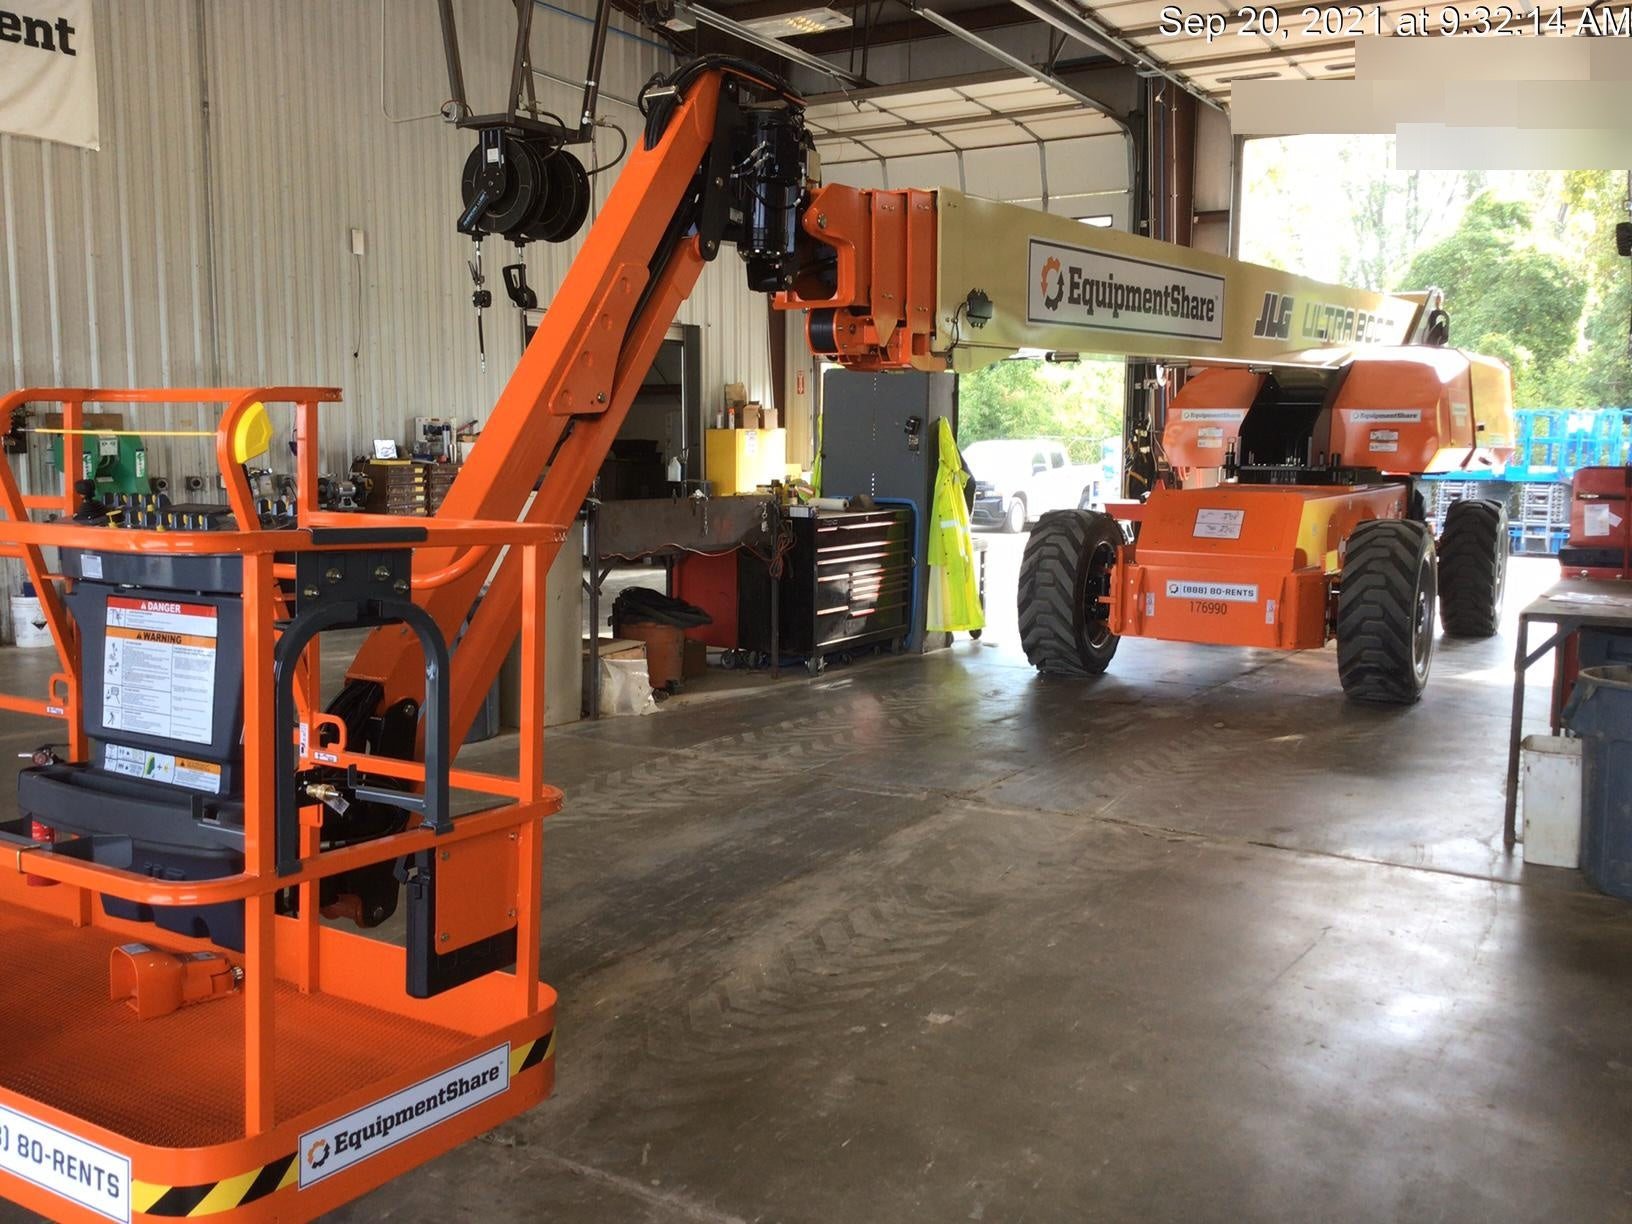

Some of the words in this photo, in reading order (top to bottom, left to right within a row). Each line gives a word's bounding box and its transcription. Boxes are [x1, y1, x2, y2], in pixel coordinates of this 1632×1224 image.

[1068, 266, 1215, 322] EquipmentShare
[1253, 291, 1294, 339] JLG
[1183, 585, 1208, 594] (888)
[1210, 587, 1254, 597] 80-RENTS
[147, 601, 181, 614] DANGER
[1189, 601, 1228, 615] 176990
[143, 631, 182, 645] WARNING
[334, 1065, 500, 1155] EquipmentShare
[17, 1133, 119, 1199] 80-RENTS
